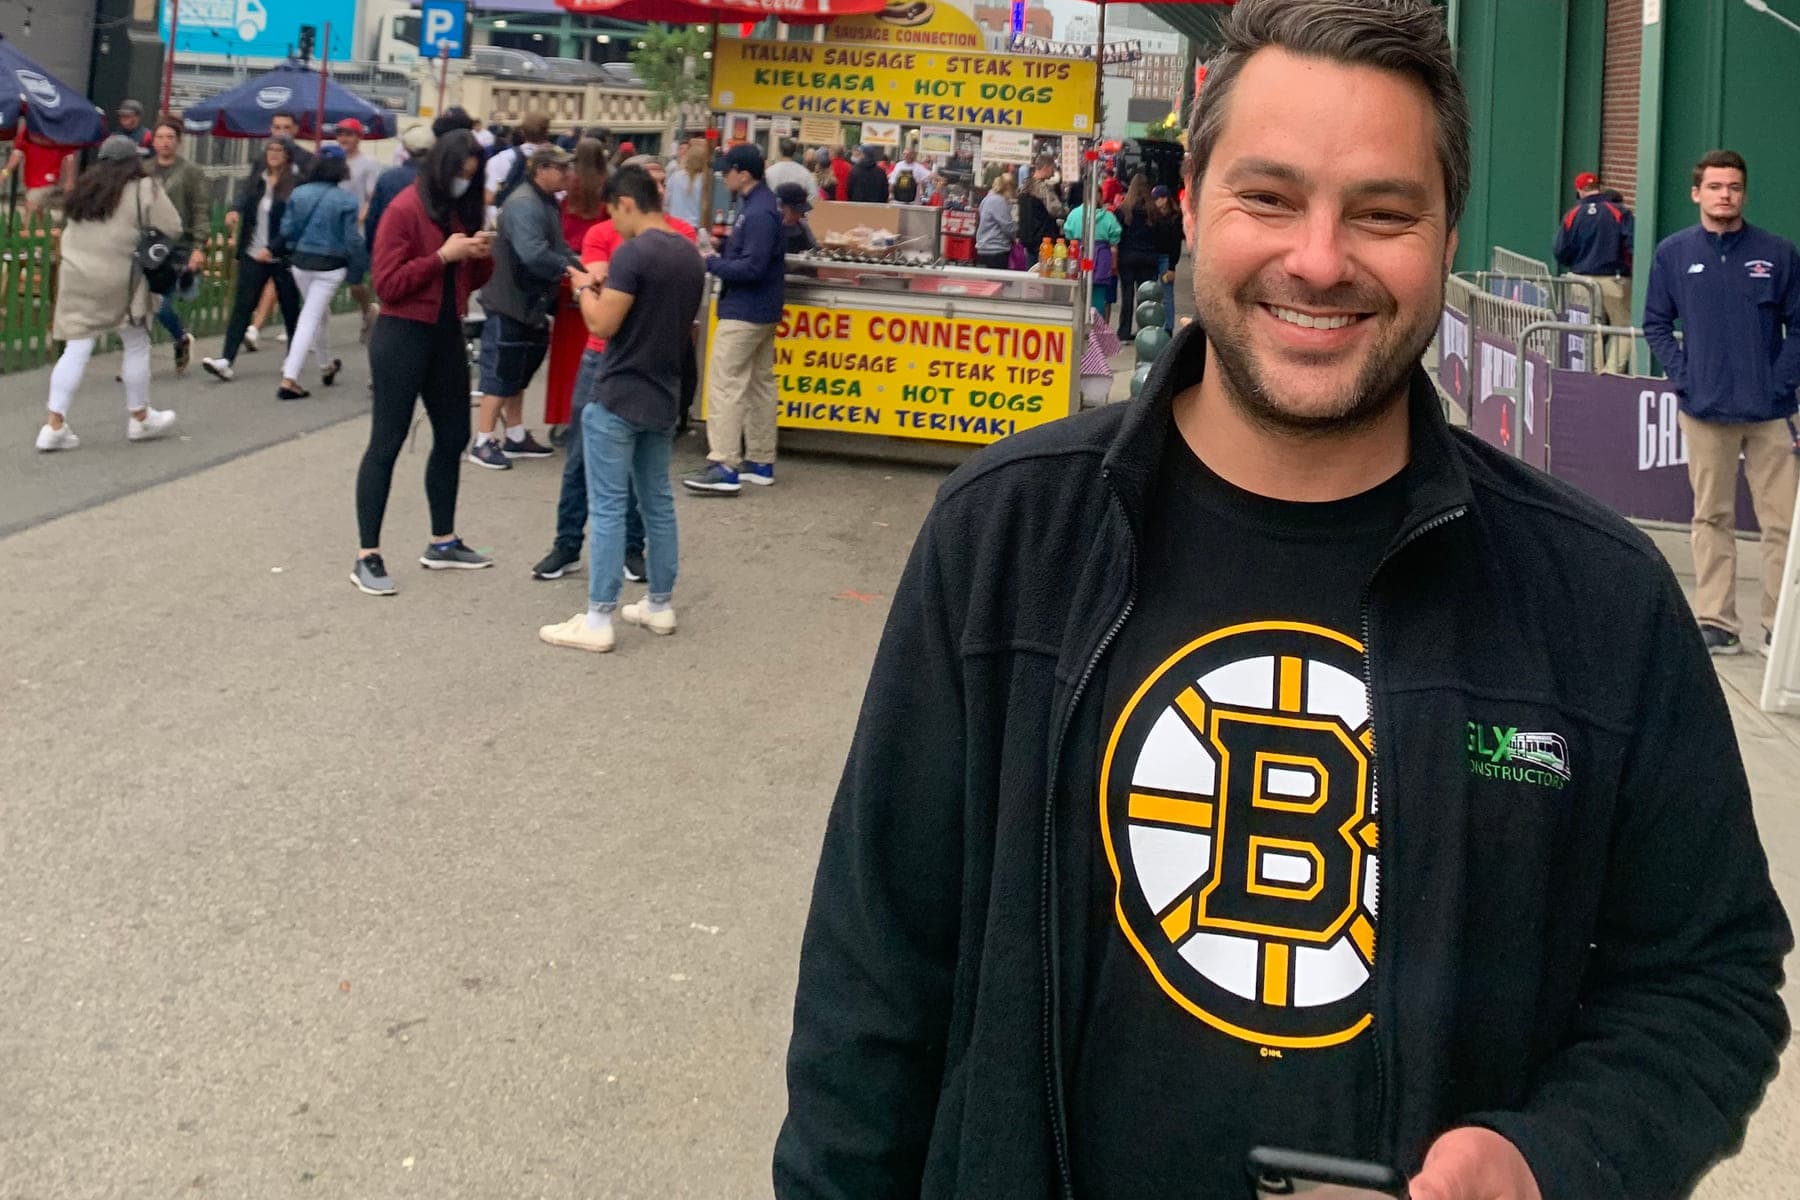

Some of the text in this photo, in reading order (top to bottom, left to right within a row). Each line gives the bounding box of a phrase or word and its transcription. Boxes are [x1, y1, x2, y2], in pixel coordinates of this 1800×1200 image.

[426, 8, 454, 45] P
[834, 24, 977, 47] SAUSAGE CONNECTION
[742, 42, 1071, 80] ITALIAN SAUSAGE STEAK TIPS
[754, 68, 1054, 104] KIELBASA HOT DOGS
[781, 94, 1023, 126] CHICKEN TERIYAKI
[868, 316, 1066, 364] CONNECTION
[804, 350, 898, 374] SAUSAGE
[928, 360, 995, 383] STEAK
[1006, 365, 1055, 388] TIPS
[902, 384, 956, 406] HOT
[968, 389, 1044, 413] DOGS
[895, 408, 1016, 437] TERIYAKI
[1197, 708, 1368, 943] B
